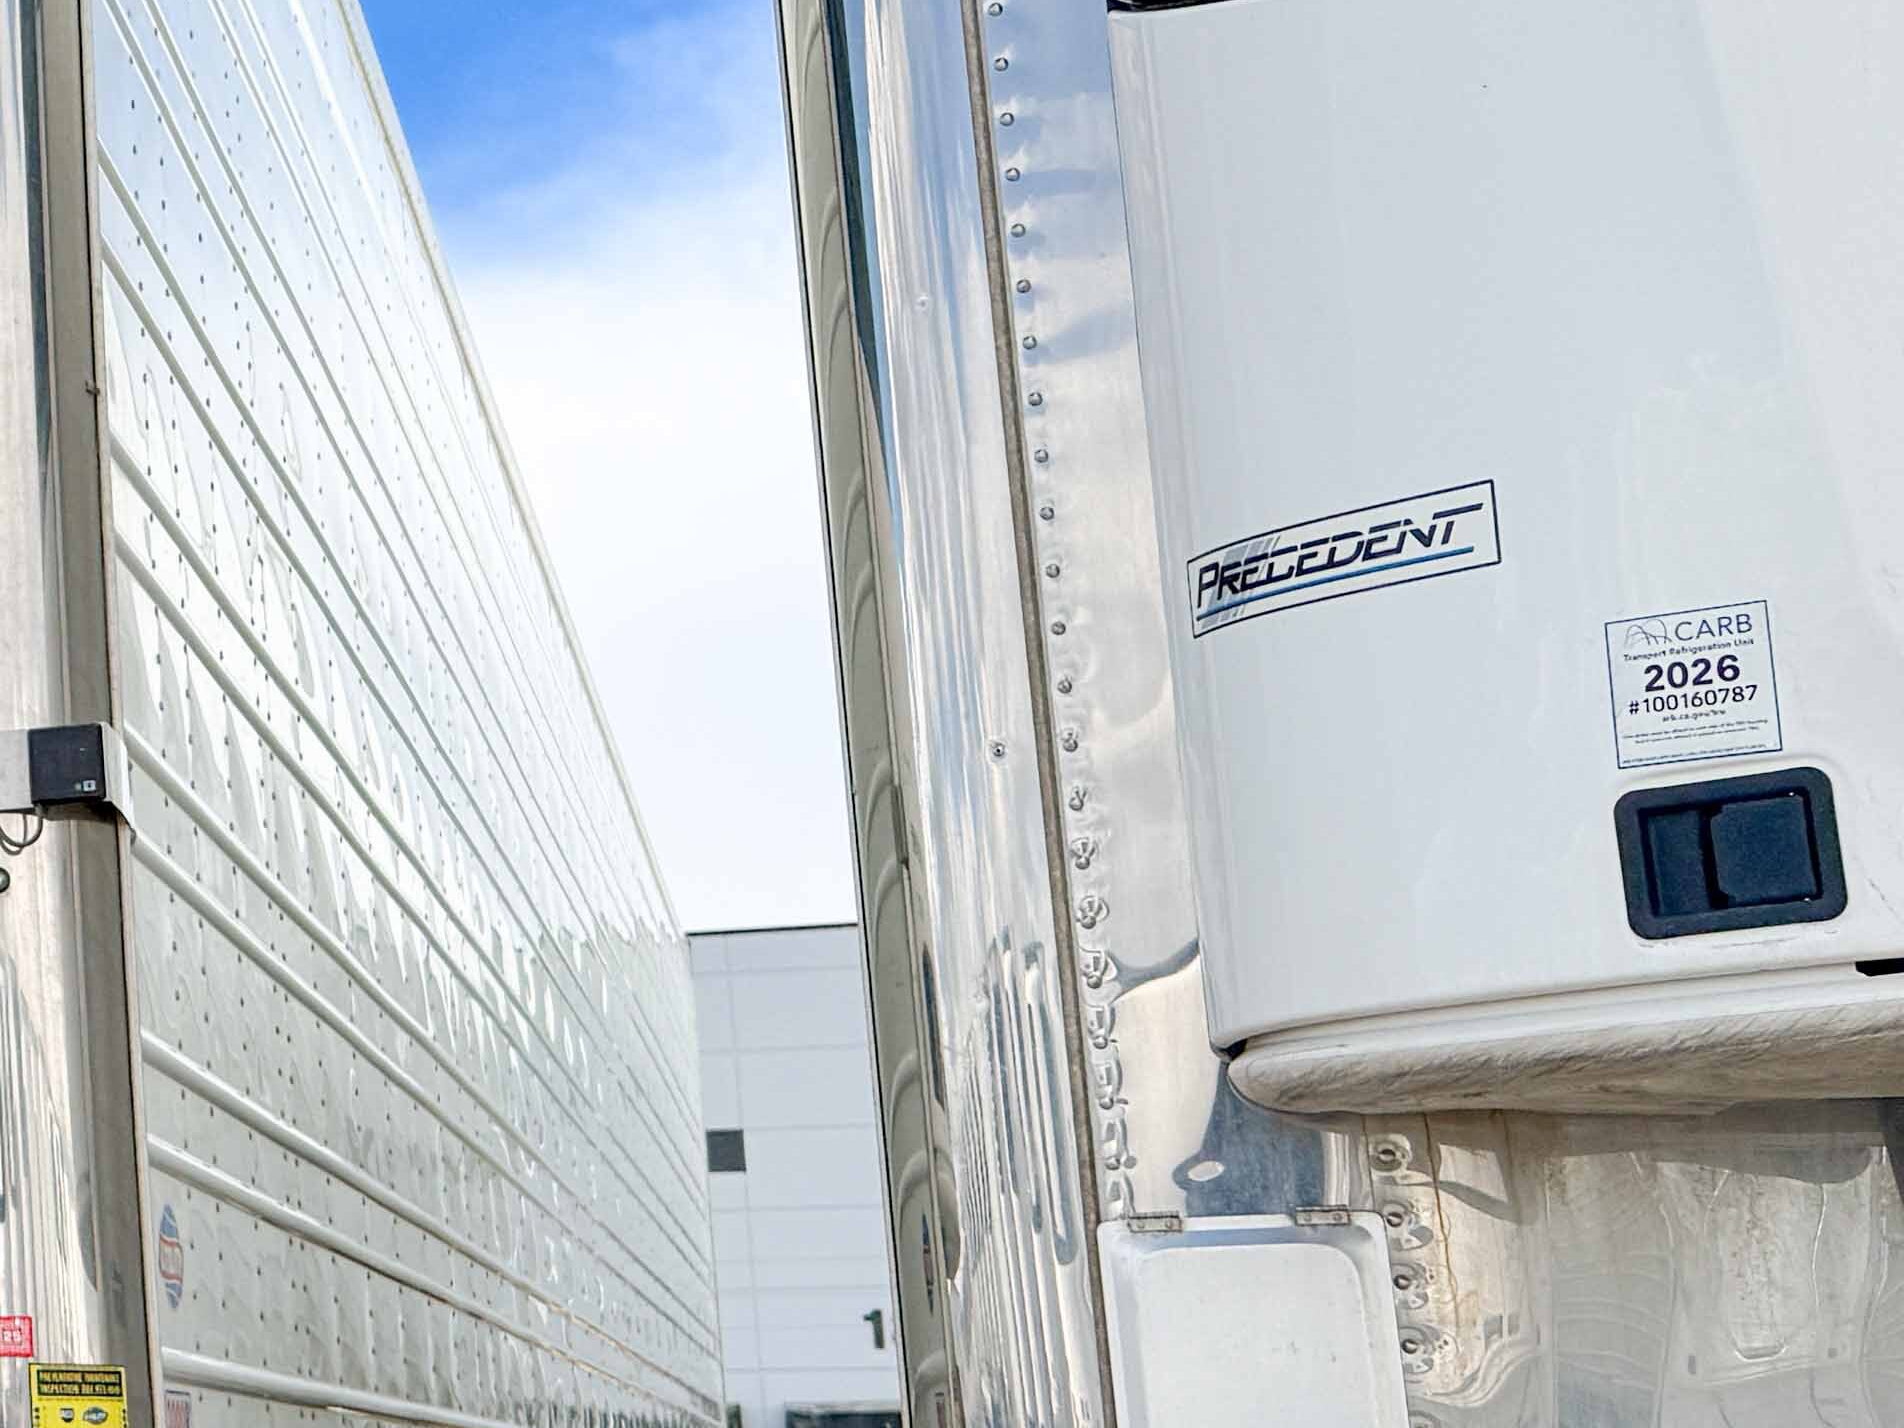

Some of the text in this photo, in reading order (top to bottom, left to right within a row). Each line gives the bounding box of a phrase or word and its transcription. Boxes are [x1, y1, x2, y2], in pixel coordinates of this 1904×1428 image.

[1674, 613, 1753, 642] CARB
[1643, 653, 1741, 693] 2026
[1628, 684, 1758, 715] #100160787
